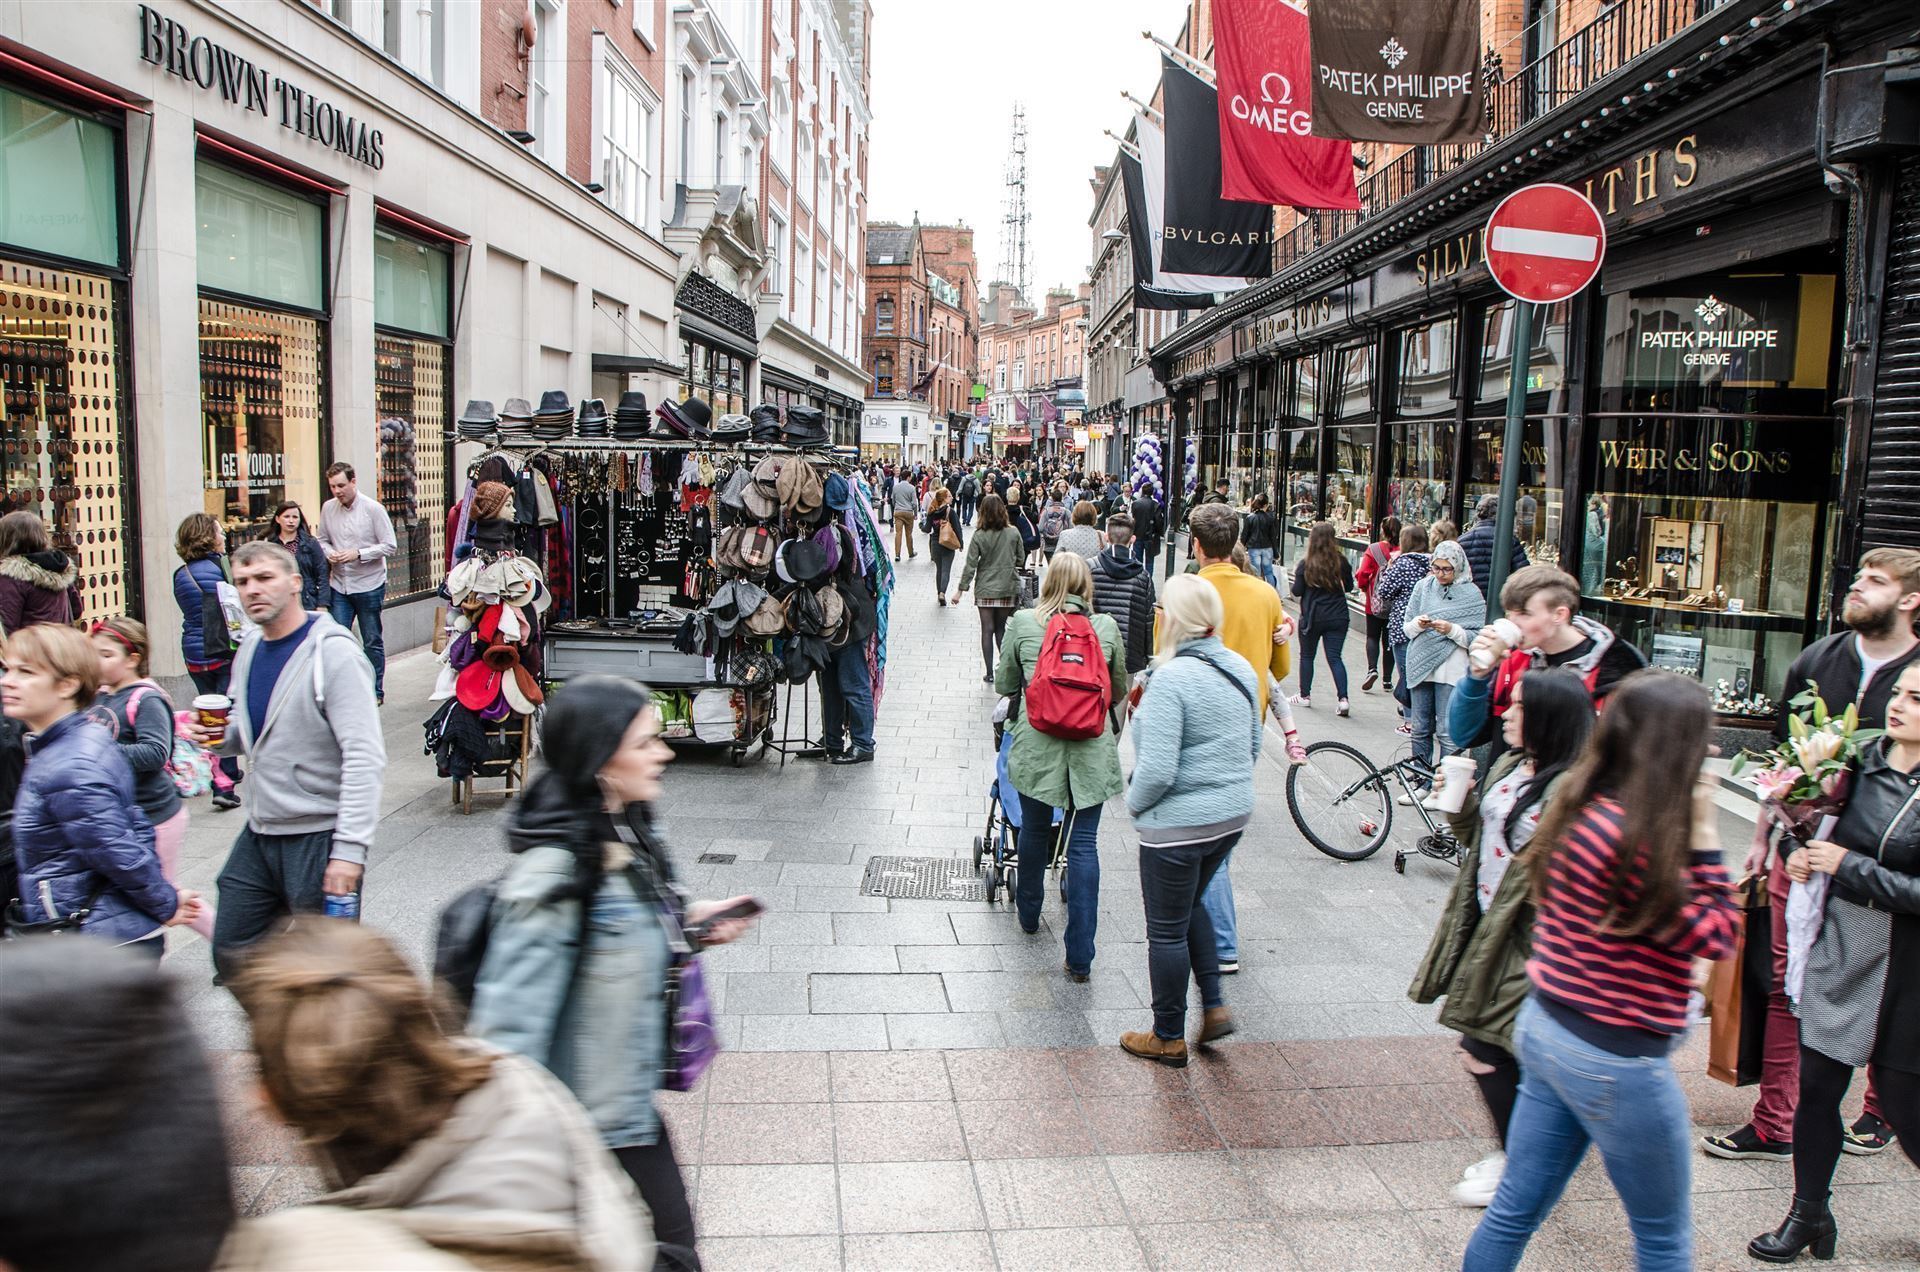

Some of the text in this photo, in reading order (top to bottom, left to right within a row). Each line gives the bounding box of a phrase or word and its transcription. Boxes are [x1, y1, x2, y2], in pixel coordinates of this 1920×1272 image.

[138, 3, 385, 171] BROWN THOMAS
[1319, 64, 1473, 98] PATEK PHILIPPE
[1230, 94, 1312, 136] OMEG
[1366, 101, 1424, 119] GENEVE
[1164, 226, 1270, 245] BVLGARI
[1276, 318, 1289, 333] AND
[1641, 330, 1778, 348] PATEK PHILIPPE
[1683, 353, 1731, 366] GENEVE
[1521, 440, 1549, 465] SONS
[1600, 440, 1792, 473] WEIR & SONS
